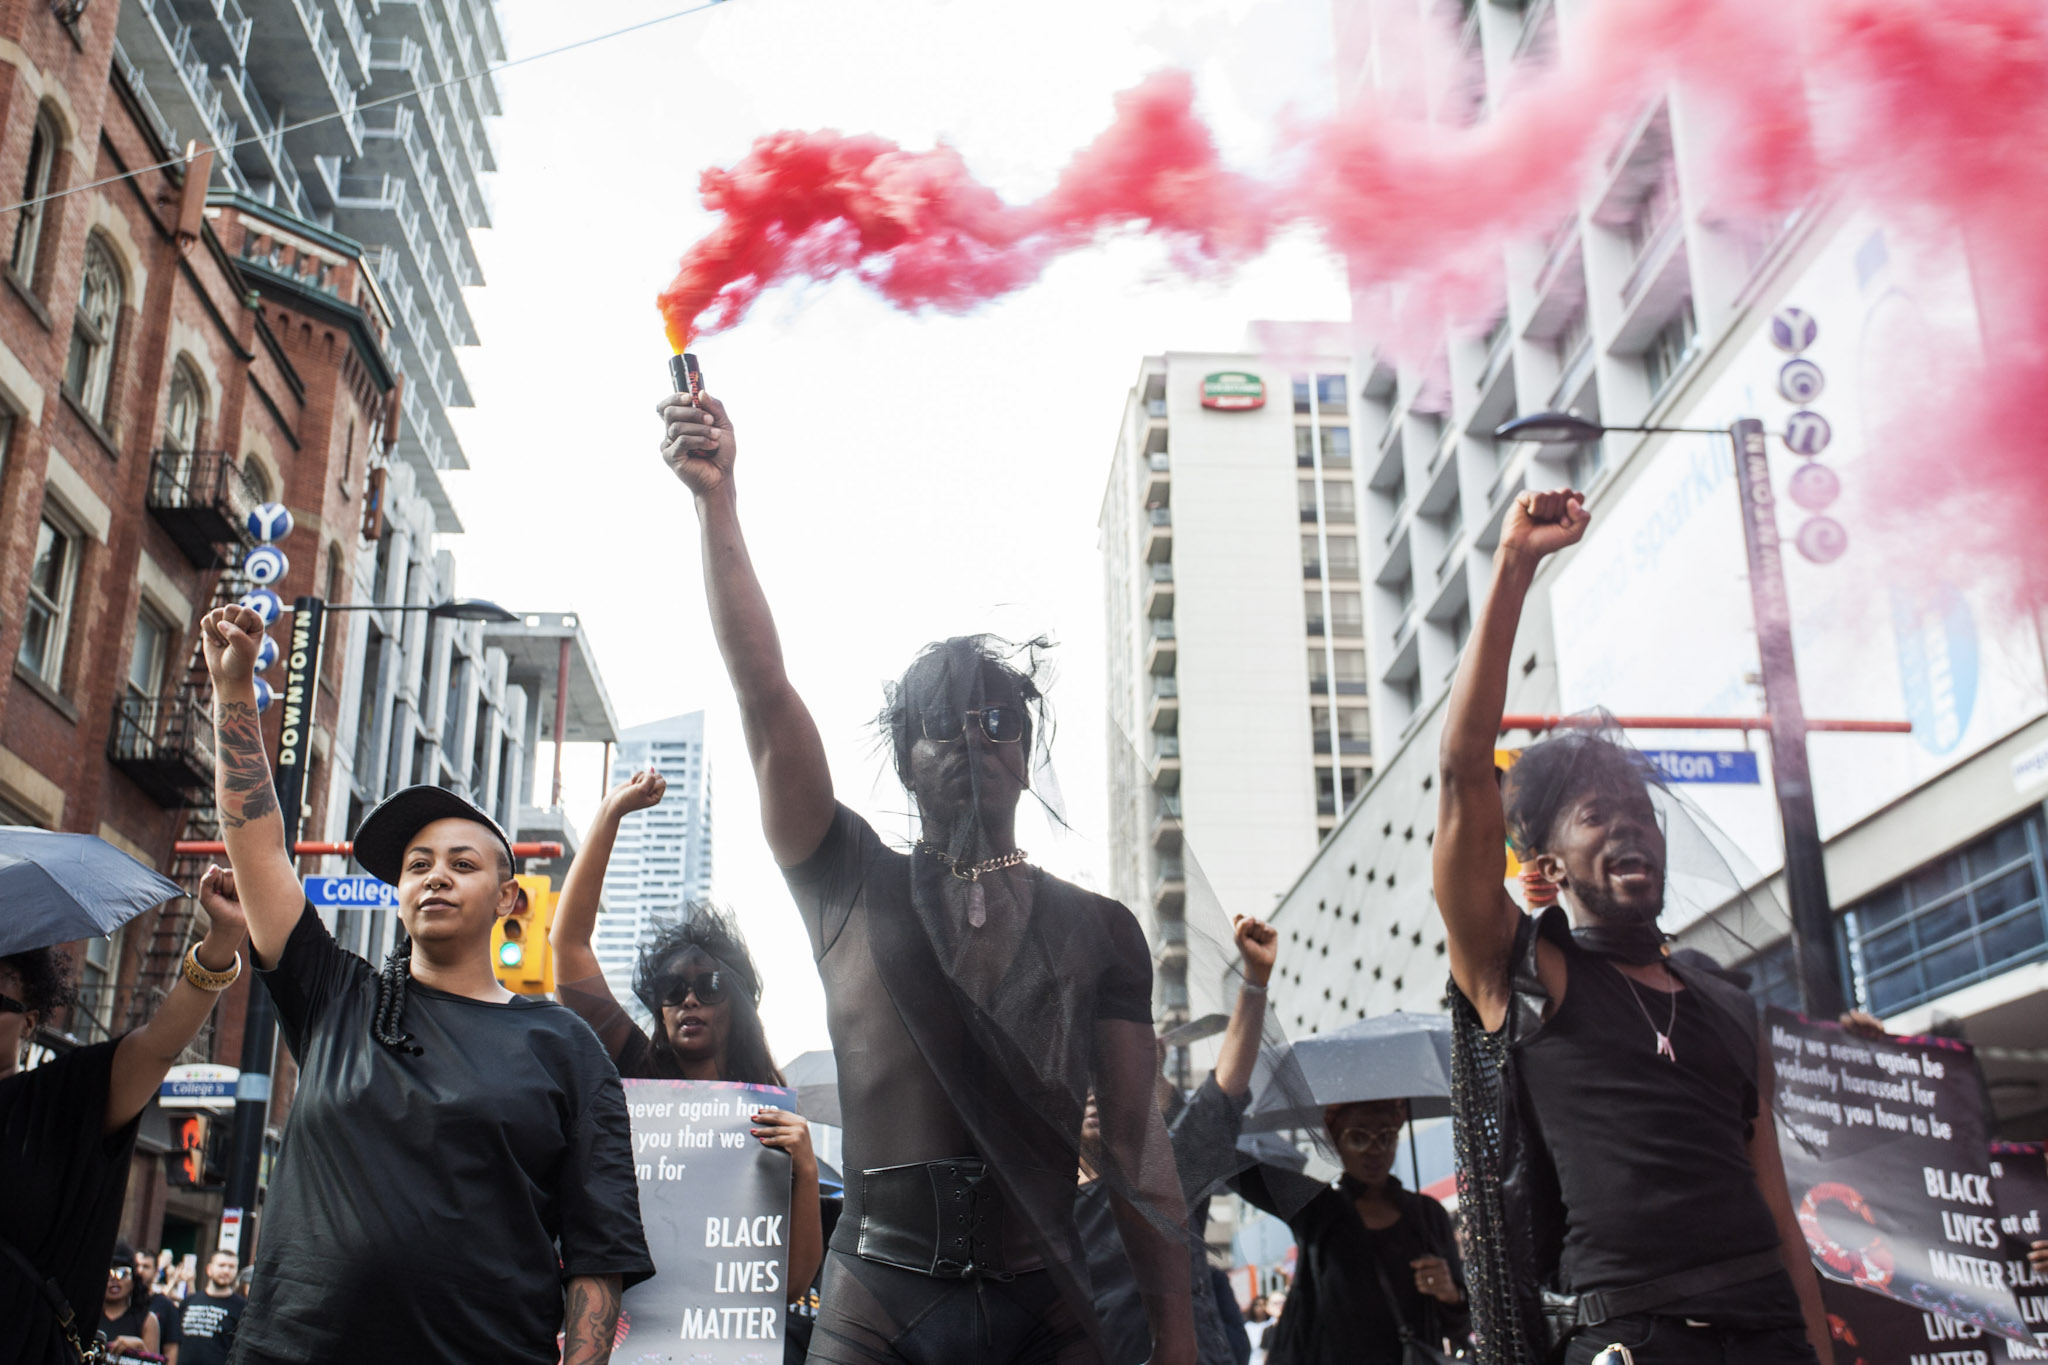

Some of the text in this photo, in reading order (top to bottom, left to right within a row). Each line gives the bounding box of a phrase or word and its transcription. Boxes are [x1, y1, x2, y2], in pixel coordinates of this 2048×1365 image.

[278, 610, 312, 766] DOWNTOWN
[1772, 1025, 1944, 1079] May we never again be
[172, 1083, 213, 1097] College
[1774, 1058, 1936, 1107] violently harassed for
[678, 1099, 731, 1122] again
[1780, 1085, 1952, 1140] showing you how to be
[638, 1124, 746, 1153] you that we
[658, 1155, 686, 1181] for
[1923, 1166, 1994, 1207] BLACK
[705, 1215, 783, 1248] BLACK
[1941, 1210, 2000, 1250] LIVES
[714, 1260, 779, 1293] LIVES
[1927, 1248, 2008, 1293] MATTER
[680, 1308, 776, 1339] MATTER
